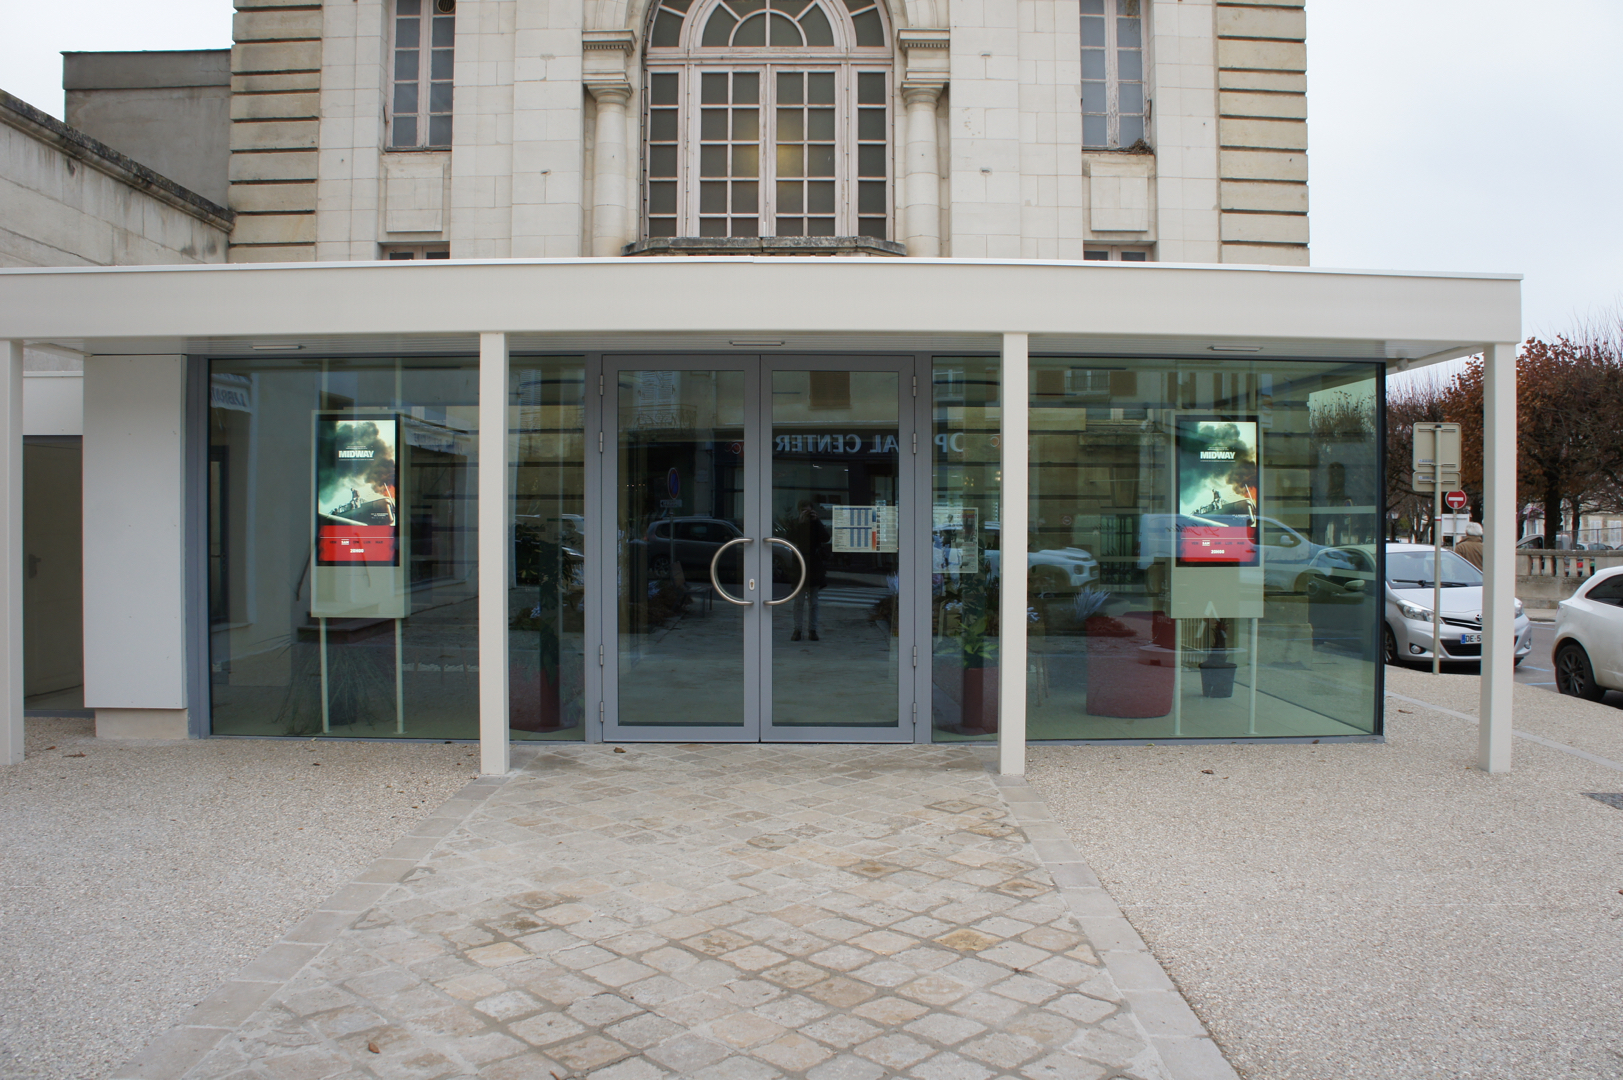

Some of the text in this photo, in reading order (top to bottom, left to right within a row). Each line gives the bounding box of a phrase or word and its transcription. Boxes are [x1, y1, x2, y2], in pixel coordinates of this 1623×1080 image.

[338, 450, 375, 458] MIDWAY
[1200, 451, 1236, 459] MIDWAY
[1465, 634, 1482, 643] DE-5
